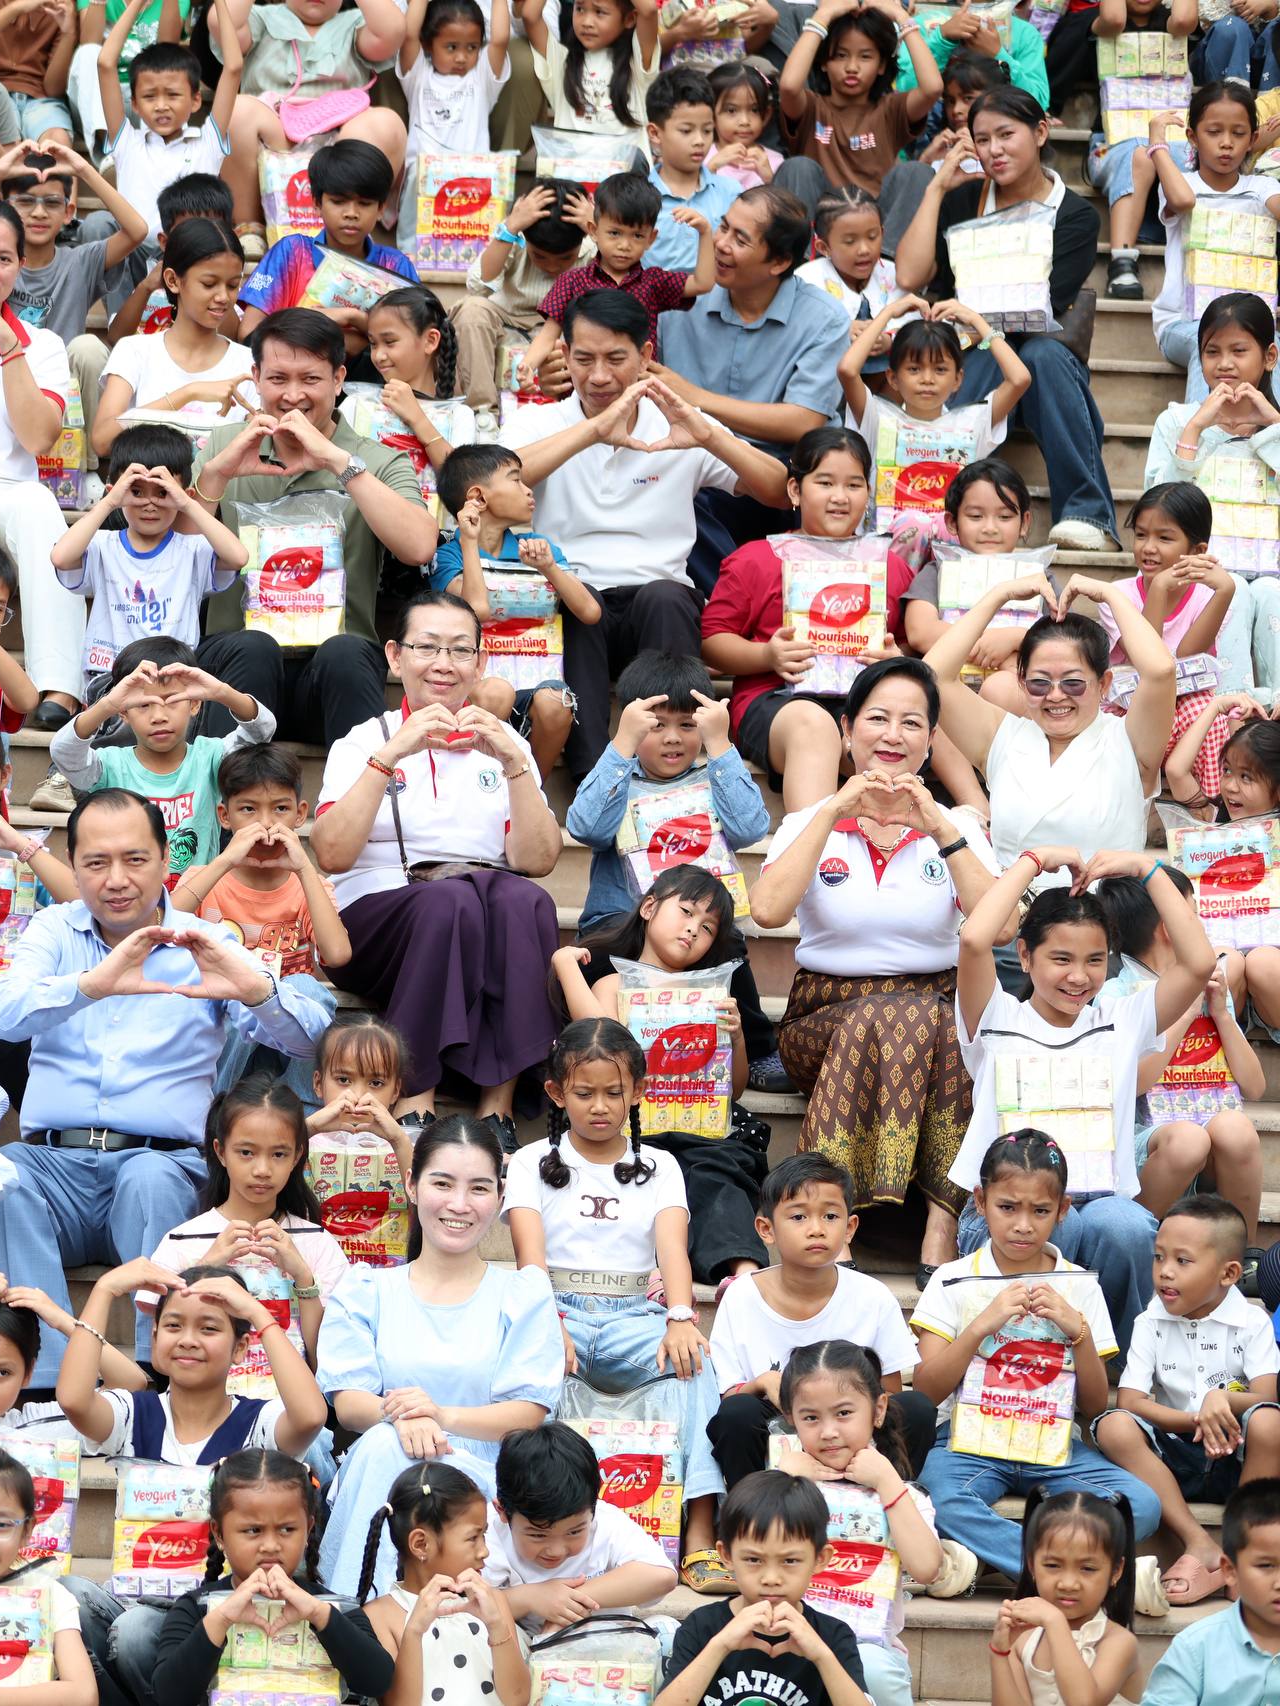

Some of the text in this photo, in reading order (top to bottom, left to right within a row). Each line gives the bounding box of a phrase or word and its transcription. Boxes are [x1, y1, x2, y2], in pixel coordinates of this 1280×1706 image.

[289, 210, 324, 221] Nouri
[290, 220, 326, 230] Good
[432, 219, 490, 232] Nourishing
[907, 472, 950, 492] Yeo's
[270, 560, 313, 586] Yeo's
[259, 592, 324, 604] Nourishing
[260, 603, 324, 614] Goodness
[822, 595, 862, 620] Yeo's
[483, 636, 547, 651] Nourishing
[808, 629, 868, 645] Nourishing
[89, 653, 110, 668] OUR
[149, 797, 193, 827] RVEL
[657, 829, 703, 862] Yeo's
[1200, 896, 1270, 909] Nourishing
[640, 1027, 665, 1039] Yeog
[662, 1037, 710, 1067] Yeo's
[1164, 1069, 1226, 1082] Nourishing
[645, 1079, 714, 1092] Nourishing
[645, 1091, 714, 1103] Goodness
[341, 1241, 386, 1255] rishing
[569, 1272, 627, 1287] CELINE
[998, 1353, 1047, 1379] Yeo's
[981, 1391, 1058, 1412] Nourishing
[980, 1404, 1056, 1425] Goodness
[600, 1468, 651, 1493] Yeo's
[133, 1490, 177, 1502] Yeogurt
[148, 1535, 198, 1564] Yeo's
[827, 1554, 865, 1572] eo's
[718, 1669, 809, 1706] BATHIN
